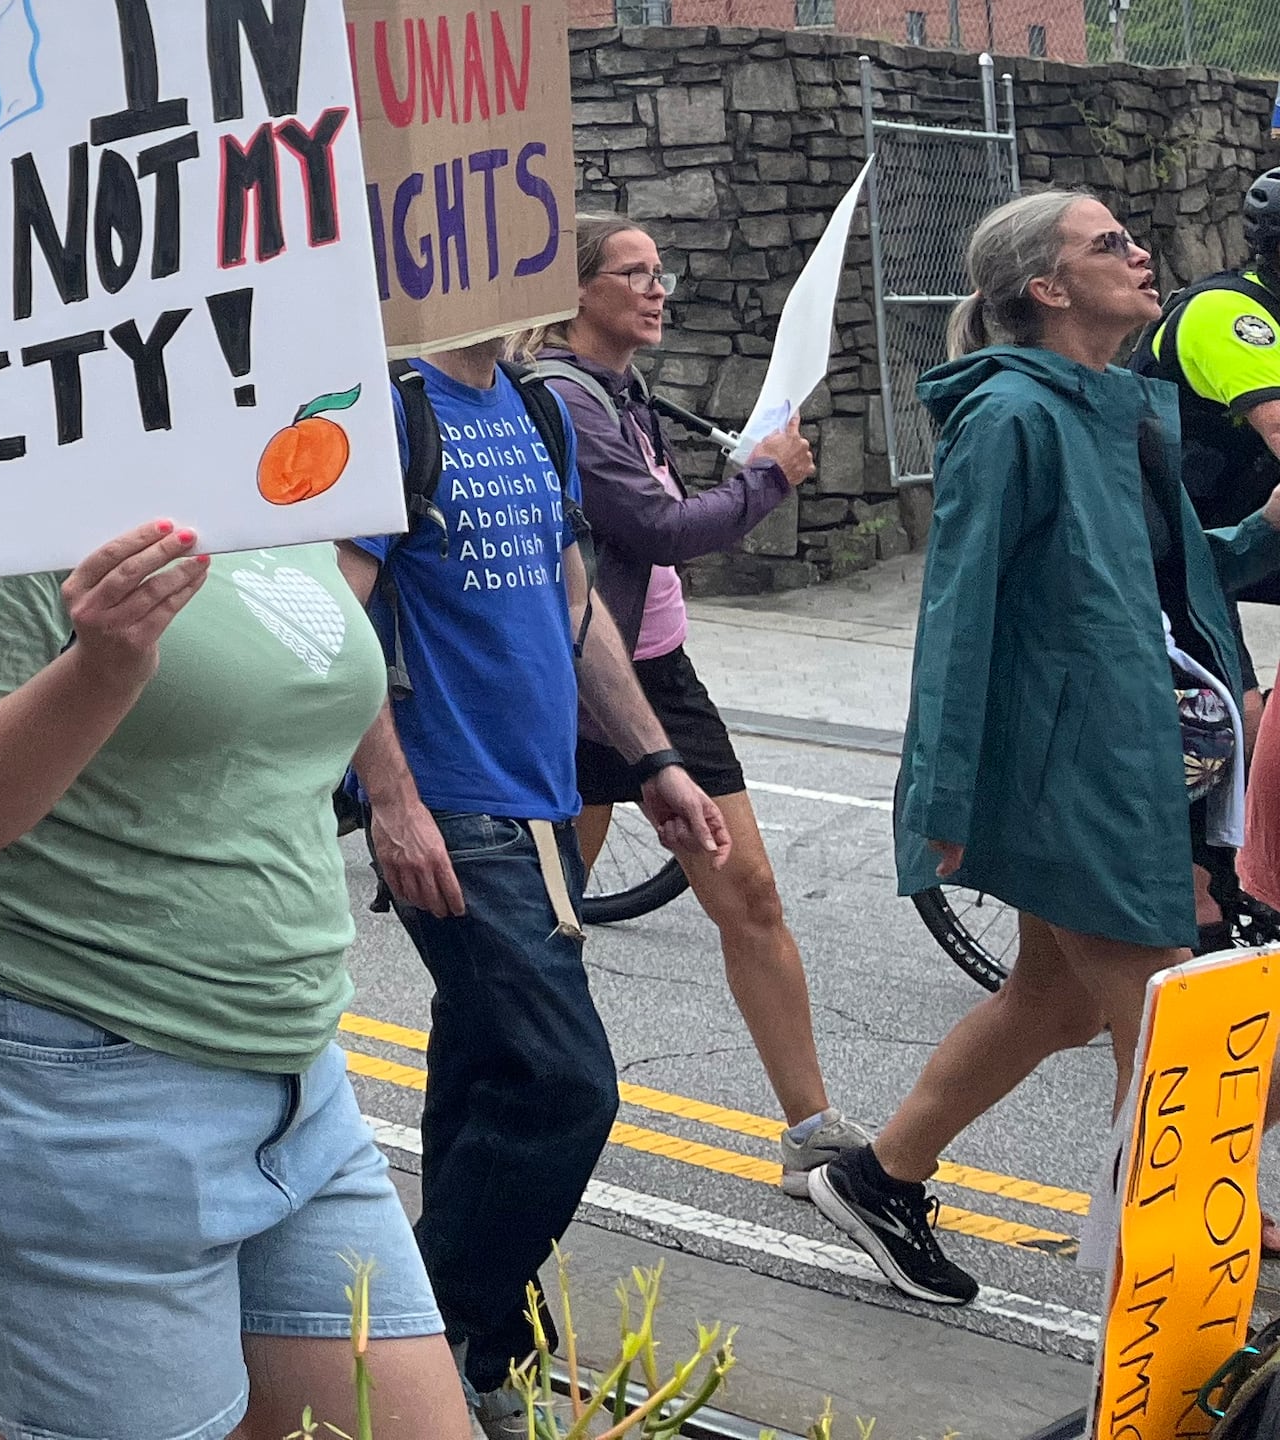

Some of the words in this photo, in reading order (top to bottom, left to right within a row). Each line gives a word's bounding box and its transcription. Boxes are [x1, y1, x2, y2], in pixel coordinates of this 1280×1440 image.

[12, 131, 199, 320] NOT
[217, 107, 349, 270] MY
[367, 142, 560, 302] IGHTS
[442, 444, 527, 471] Abolish
[451, 473, 537, 501] Abolish
[457, 504, 542, 532] Abolish
[459, 533, 543, 561] Abolish
[463, 562, 548, 592] Abolish
[1139, 1066, 1189, 1208] NOT
[1198, 1010, 1270, 1337] DEPORT
